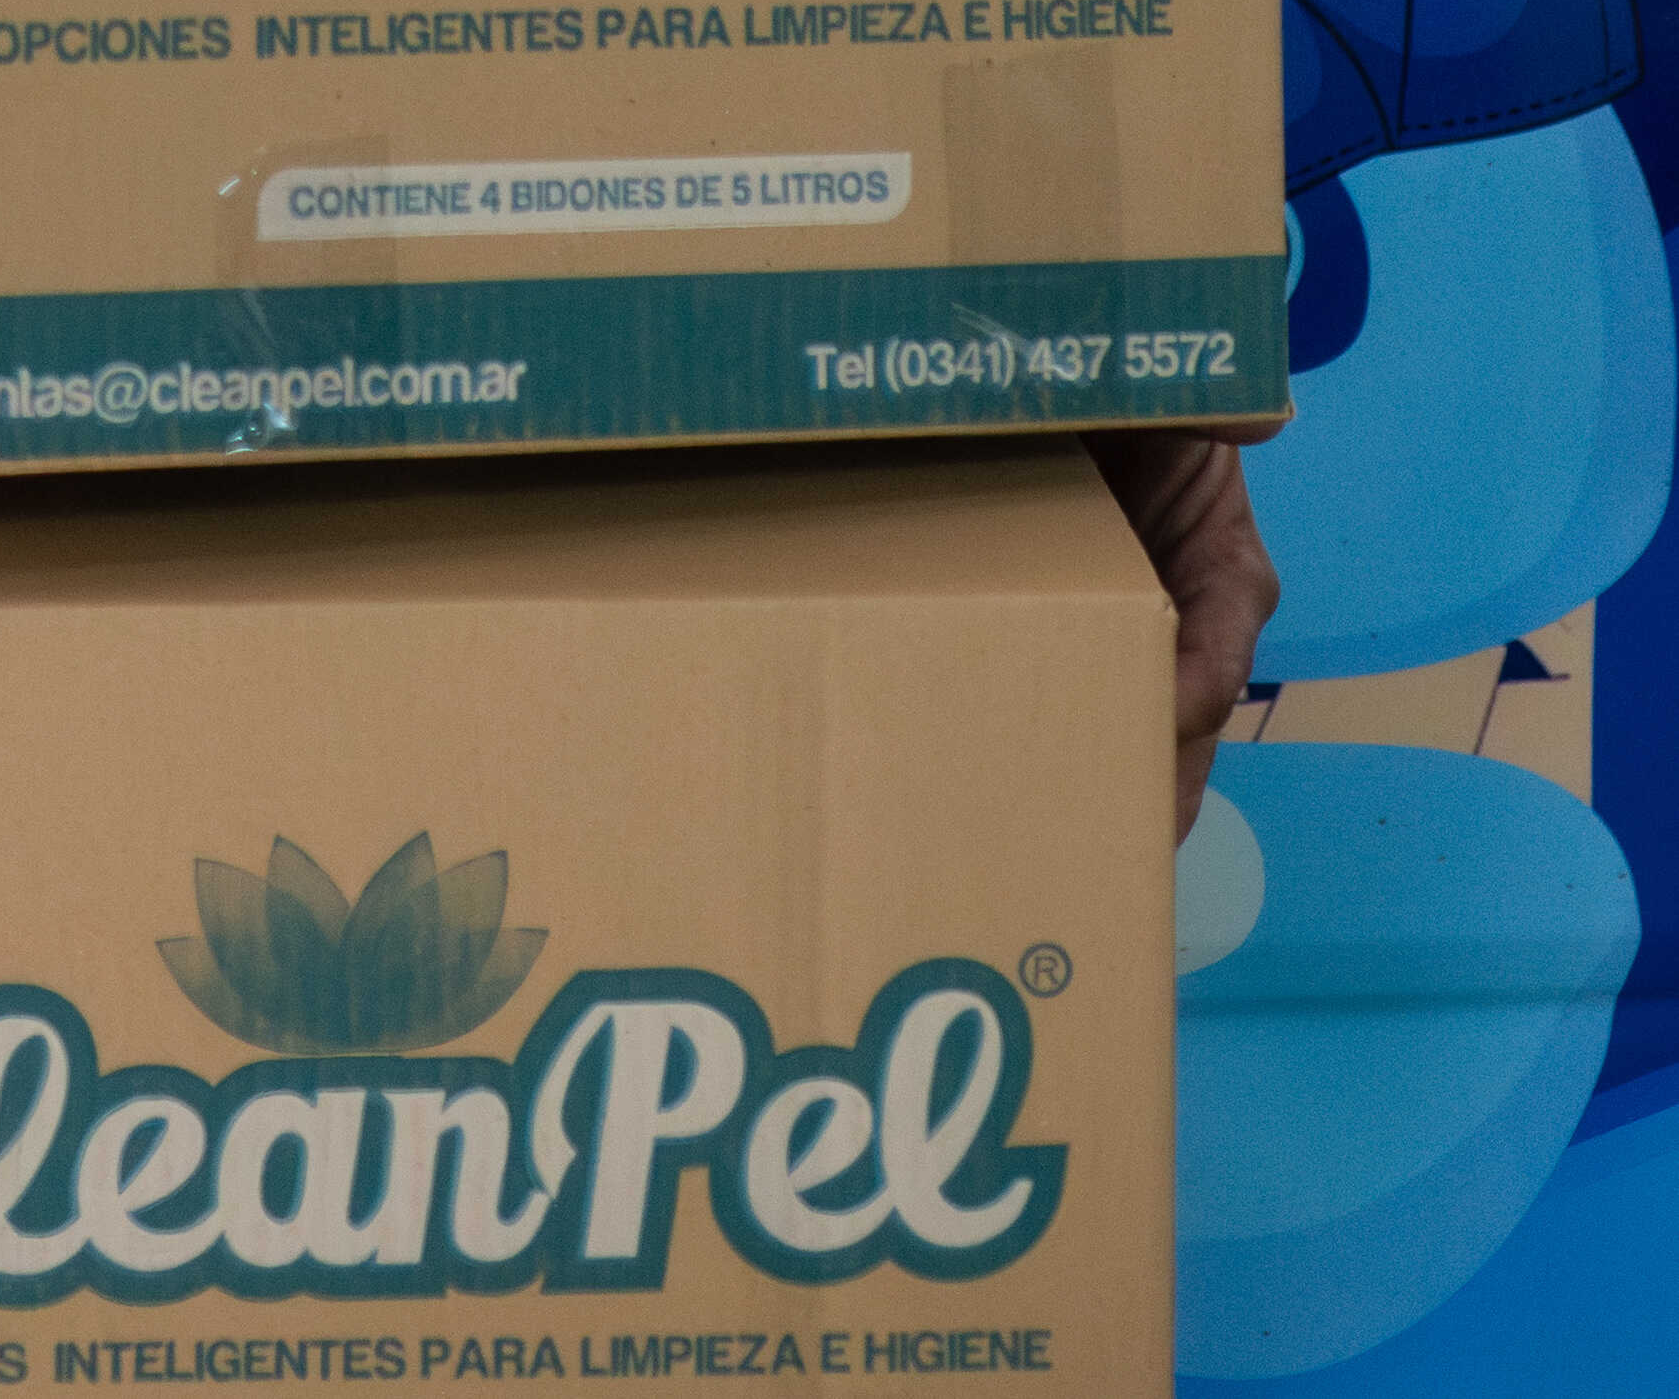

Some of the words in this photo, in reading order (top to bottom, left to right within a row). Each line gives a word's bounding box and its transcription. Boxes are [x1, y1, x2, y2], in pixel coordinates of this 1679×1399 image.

[256, 9, 585, 59] INTELIGENTES
[597, 6, 731, 49] PARA
[744, 3, 951, 46] LIMPIEZA
[964, 0, 992, 39] E
[288, 182, 472, 219] CONTIENE
[479, 181, 501, 214] 4
[510, 176, 666, 213] BIDONES
[676, 175, 721, 208] DE
[732, 173, 753, 206] 5
[760, 170, 890, 206] LITROS
[806, 343, 874, 390] Tel
[886, 337, 1016, 394] (0341)
[1027, 335, 1111, 381] 437
[1125, 332, 1235, 378] 5572
[54, 1338, 407, 1384] INTELIGENTES
[422, 1337, 565, 1380] PARA
[580, 1333, 807, 1377] LIMPIEZA
[821, 1332, 850, 1373] E
[863, 1329, 1052, 1372] HIGIENE
